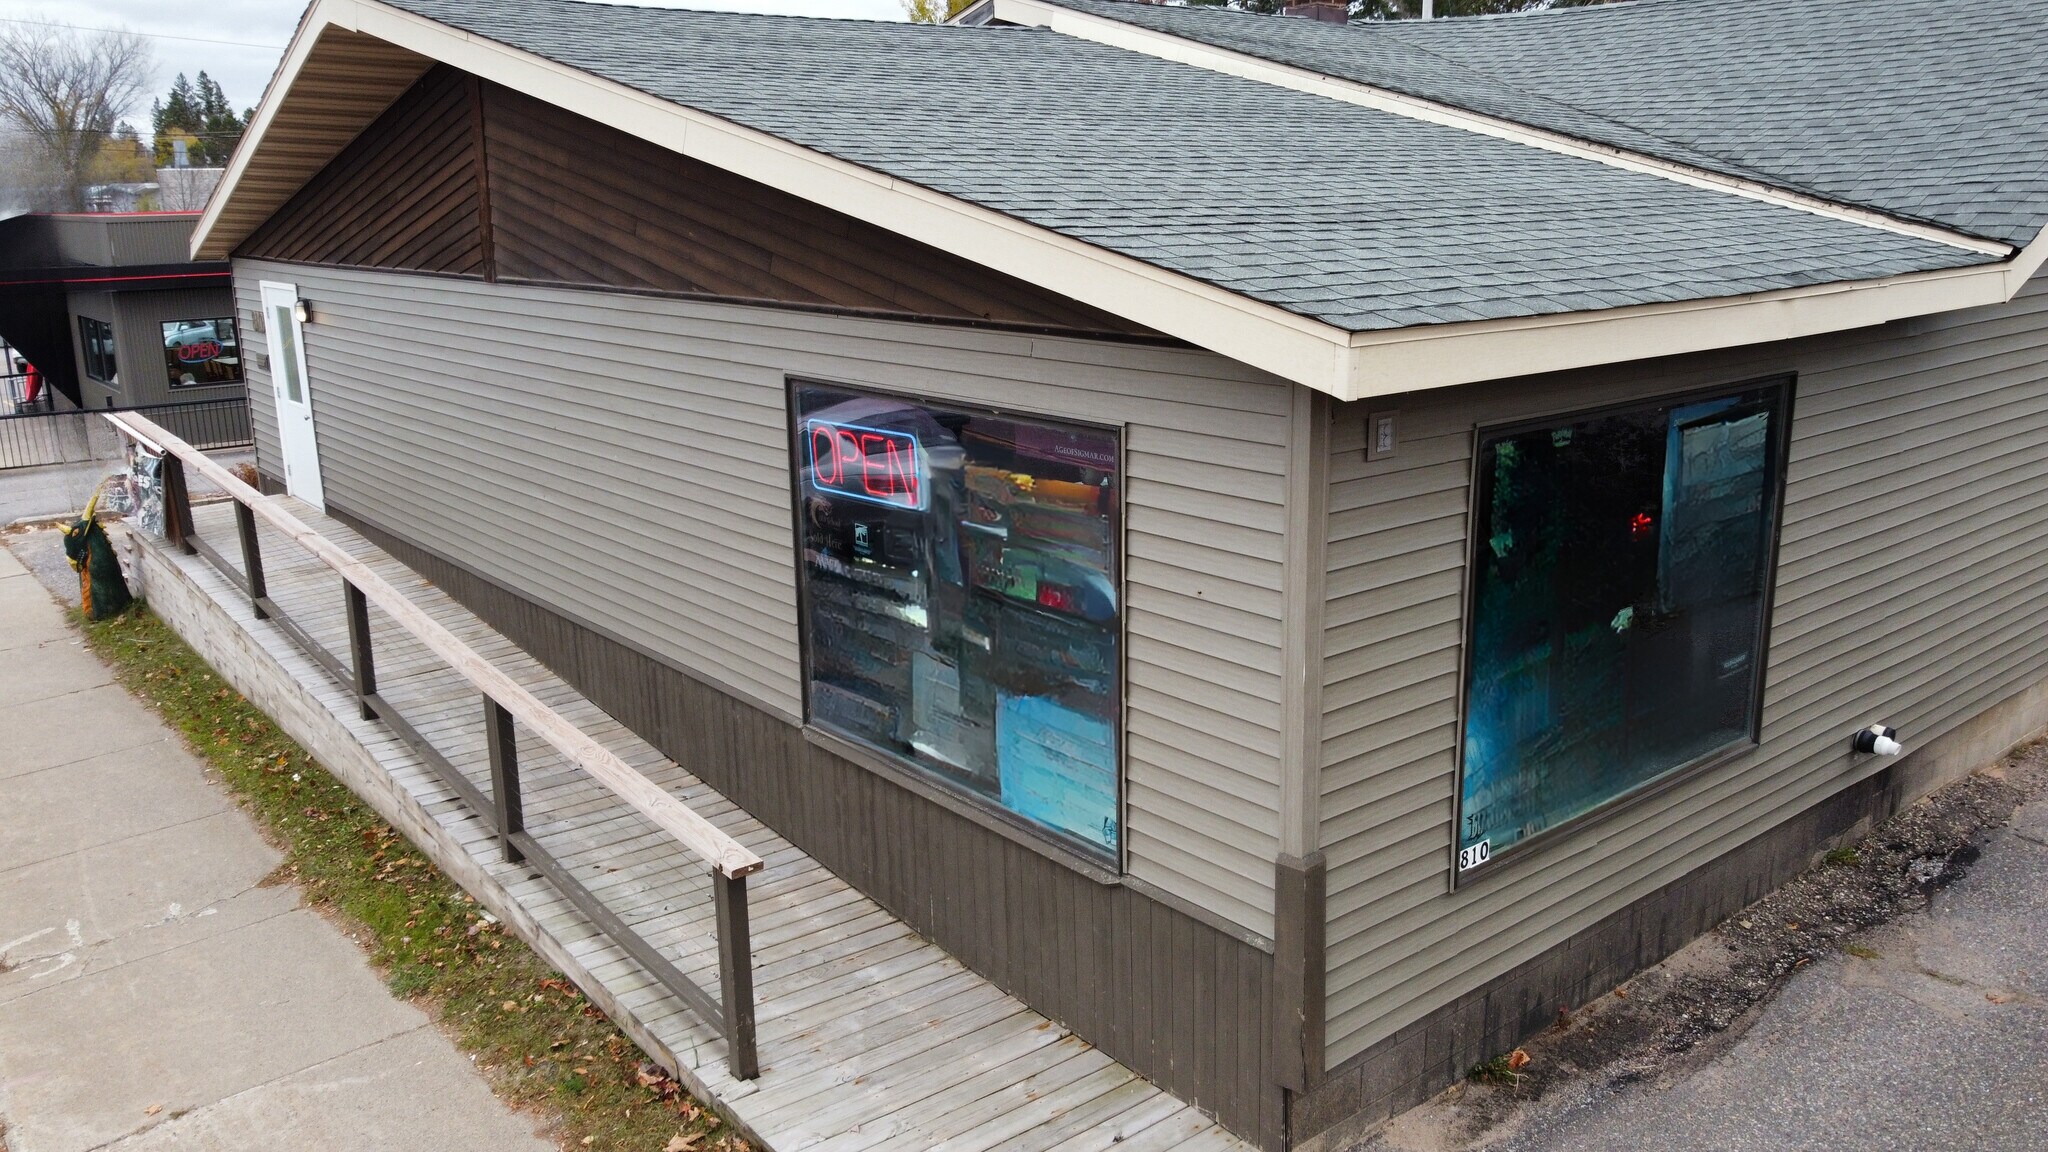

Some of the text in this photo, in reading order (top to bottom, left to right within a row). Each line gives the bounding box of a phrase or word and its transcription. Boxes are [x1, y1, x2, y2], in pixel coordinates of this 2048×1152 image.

[178, 342, 219, 359] OPEN
[1055, 445, 1115, 463] AGEOFSIGMAR.COM
[812, 427, 917, 505] OPEN
[1460, 841, 1489, 869] 810
